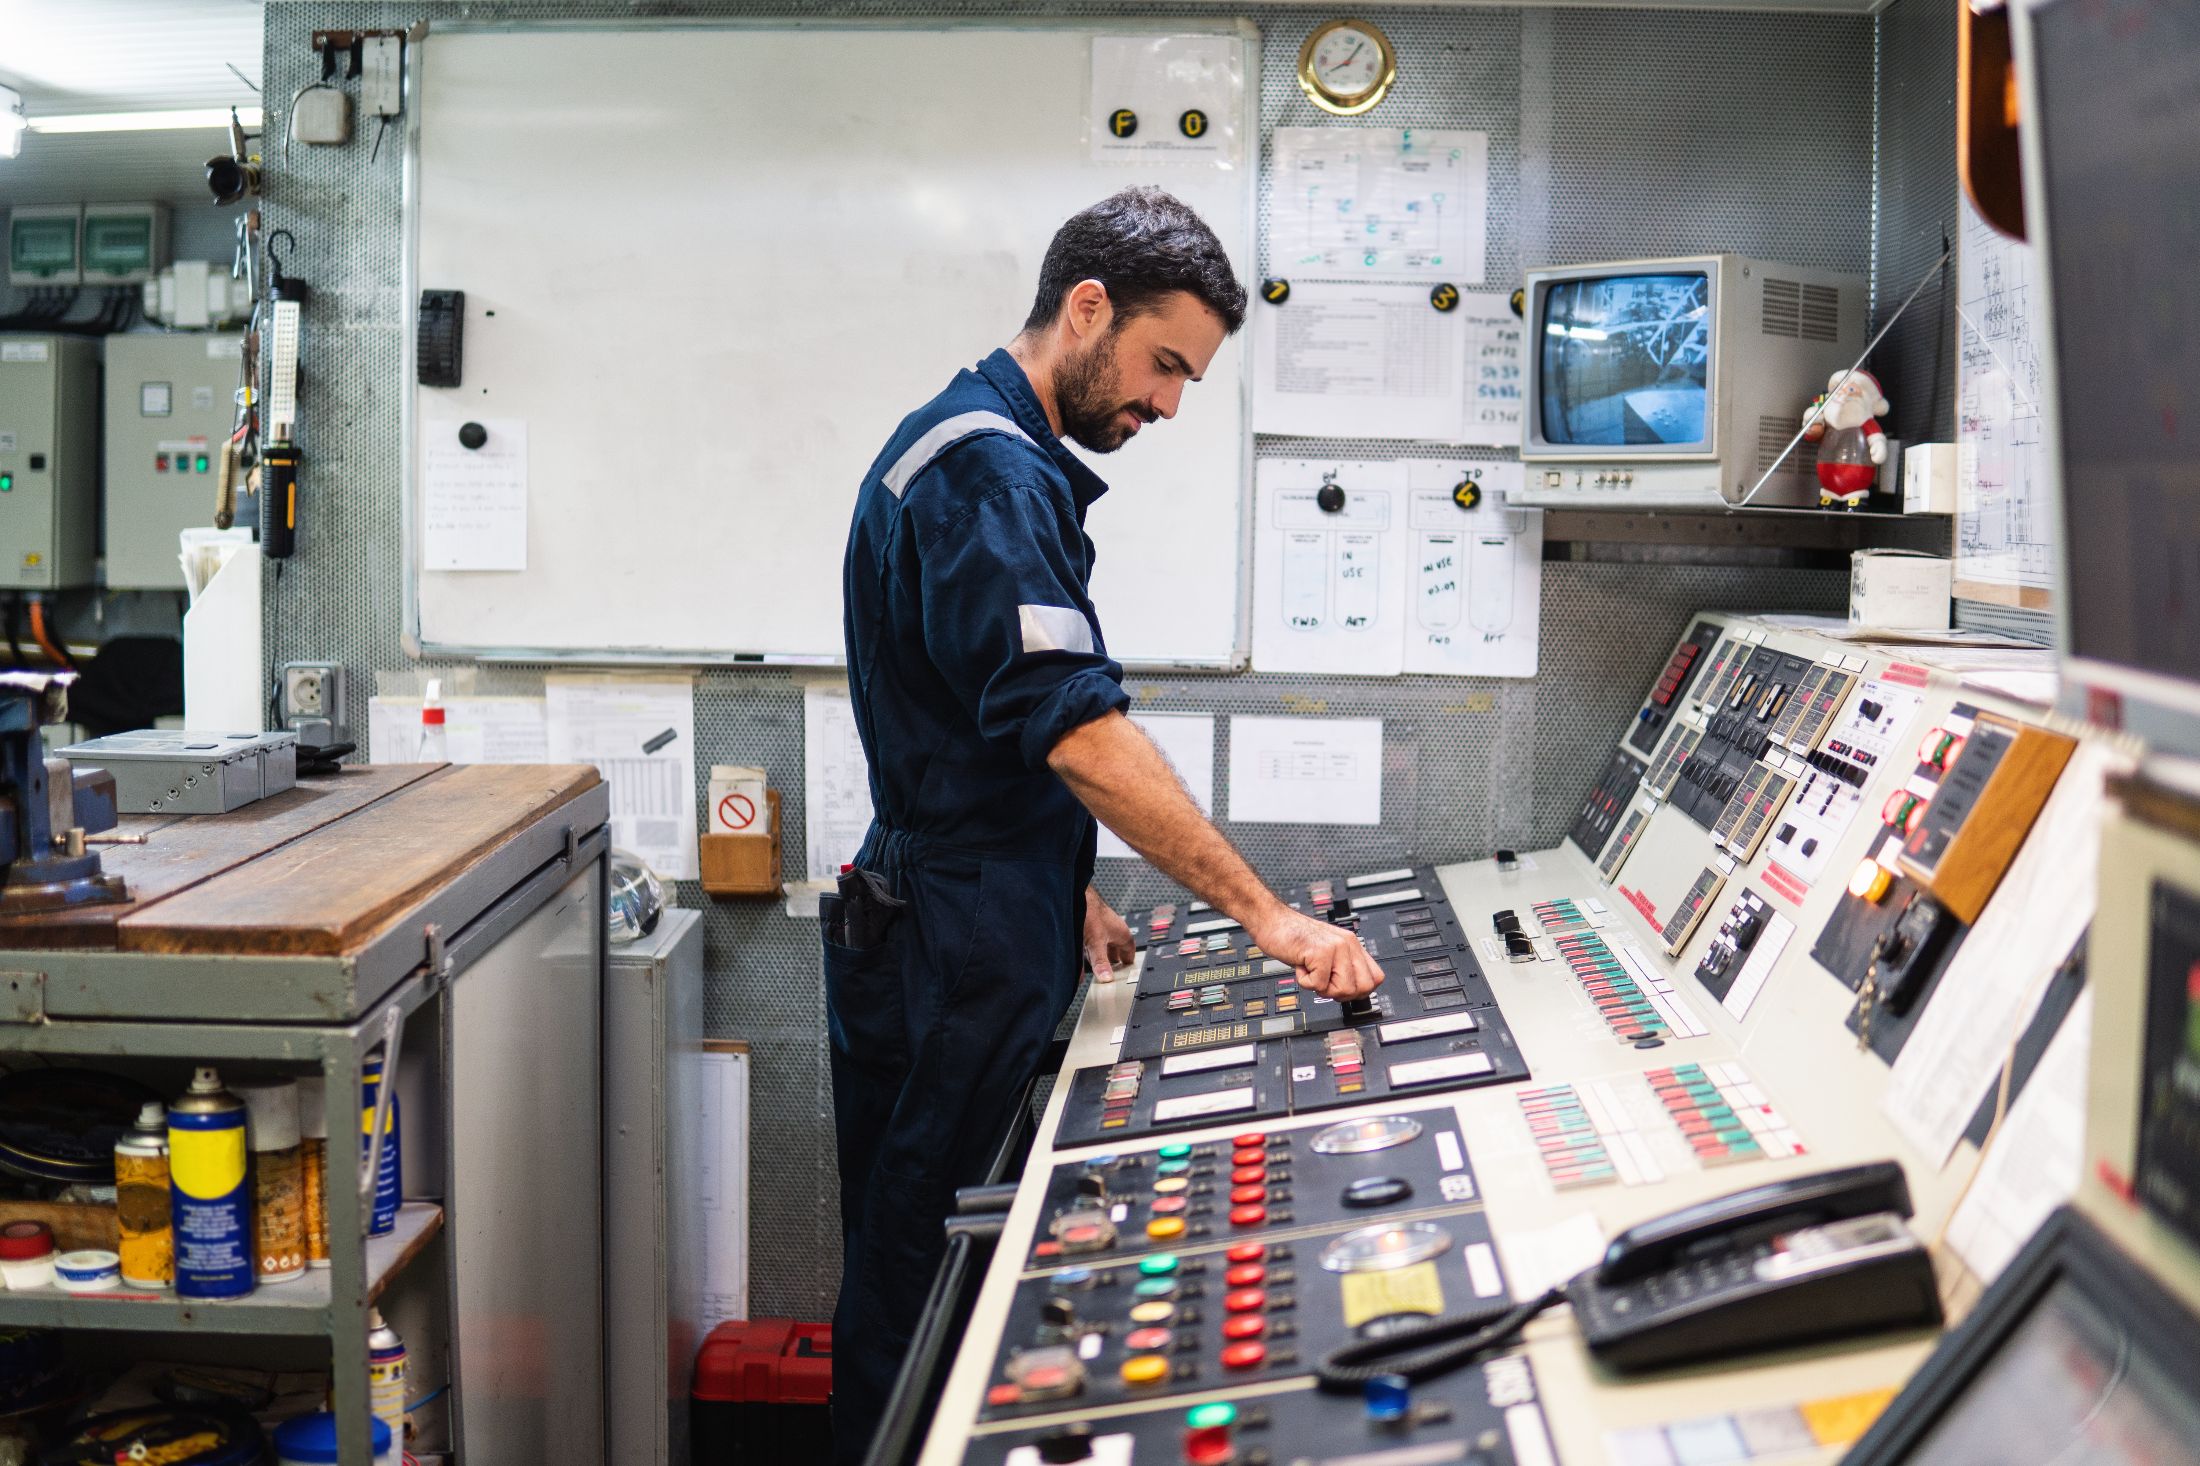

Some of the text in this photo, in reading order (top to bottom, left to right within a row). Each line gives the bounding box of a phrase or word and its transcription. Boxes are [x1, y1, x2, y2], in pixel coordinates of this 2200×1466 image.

[1115, 111, 1134, 137] F
[1433, 286, 1456, 309] 3
[1456, 482, 1475, 507] 4
[1342, 566, 1364, 578] USE
[1292, 616, 1319, 627] FWD
[1428, 634, 1451, 644] FWD
[1482, 632, 1506, 644] AFT
